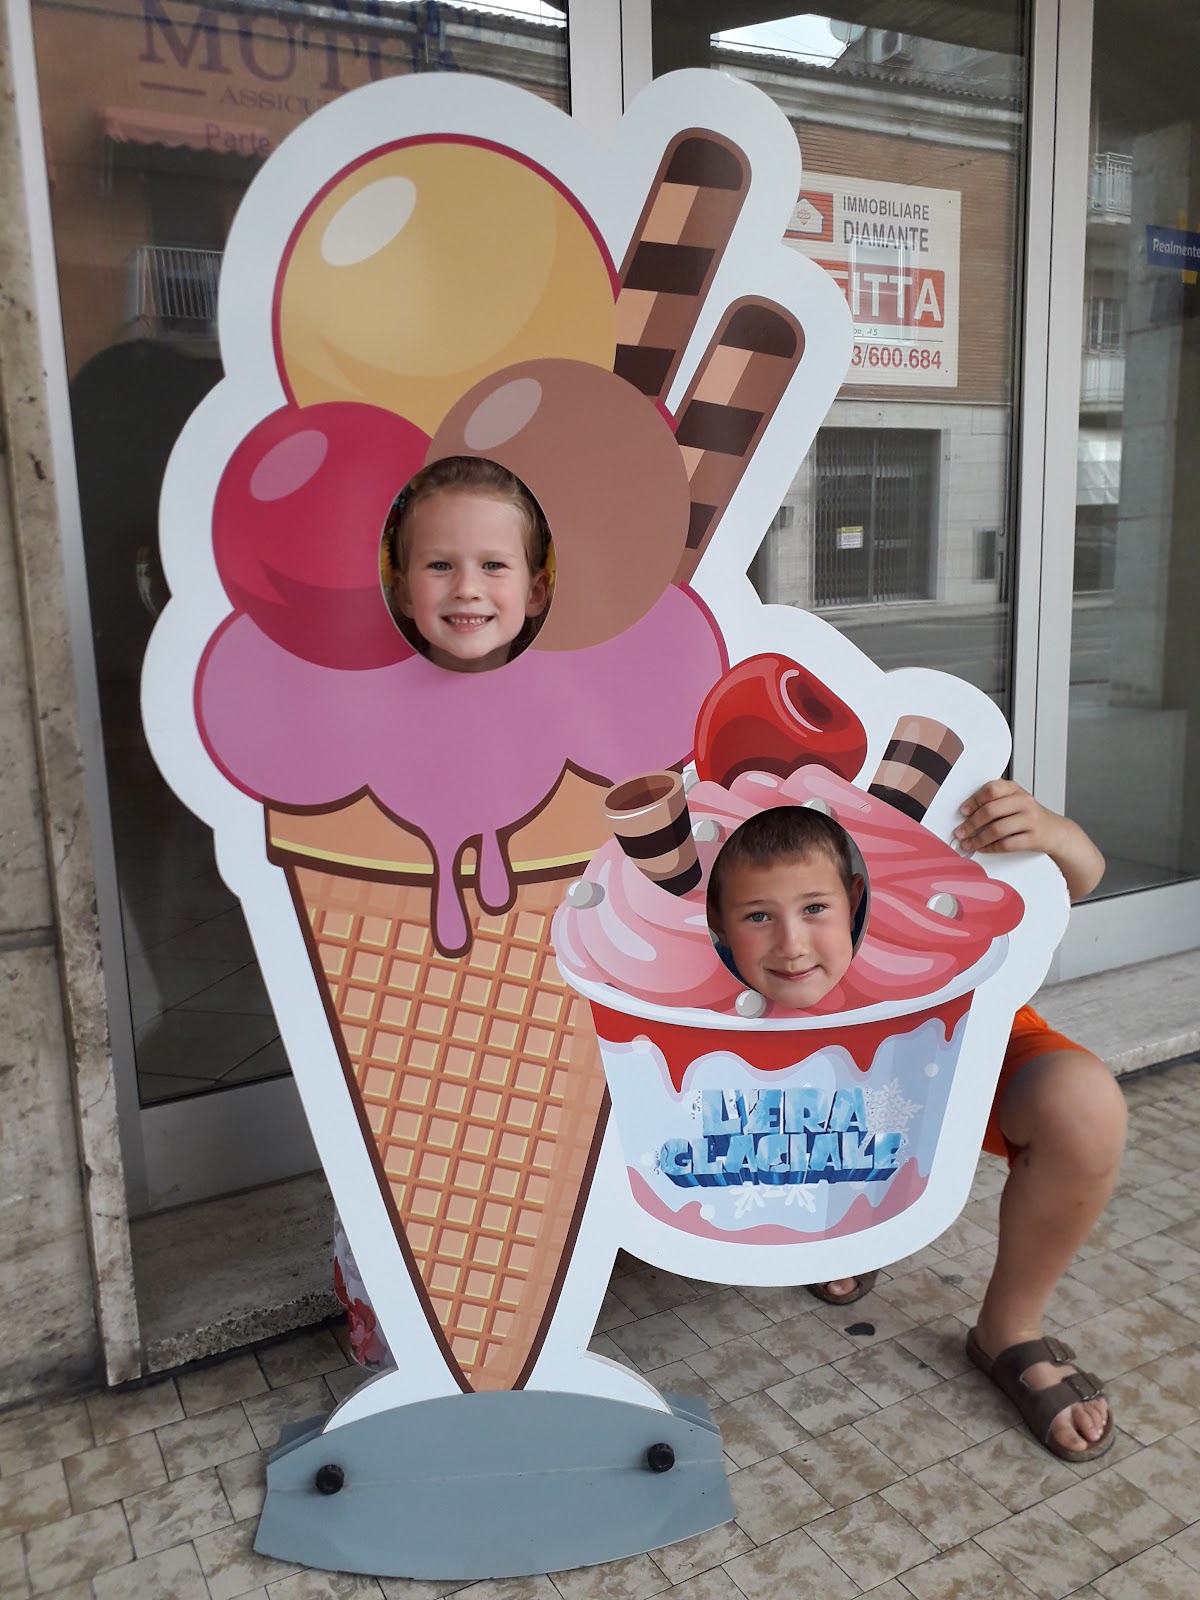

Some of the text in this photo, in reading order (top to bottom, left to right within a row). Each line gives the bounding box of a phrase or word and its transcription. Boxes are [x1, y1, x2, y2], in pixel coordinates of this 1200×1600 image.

[204, 122, 273, 155] Parte
[843, 195, 930, 221] IMMOBILIARE
[843, 219, 929, 252] DIAMANTE
[702, 1086, 868, 1136] L'ERA
[660, 1132, 902, 1187] GLACIALE
